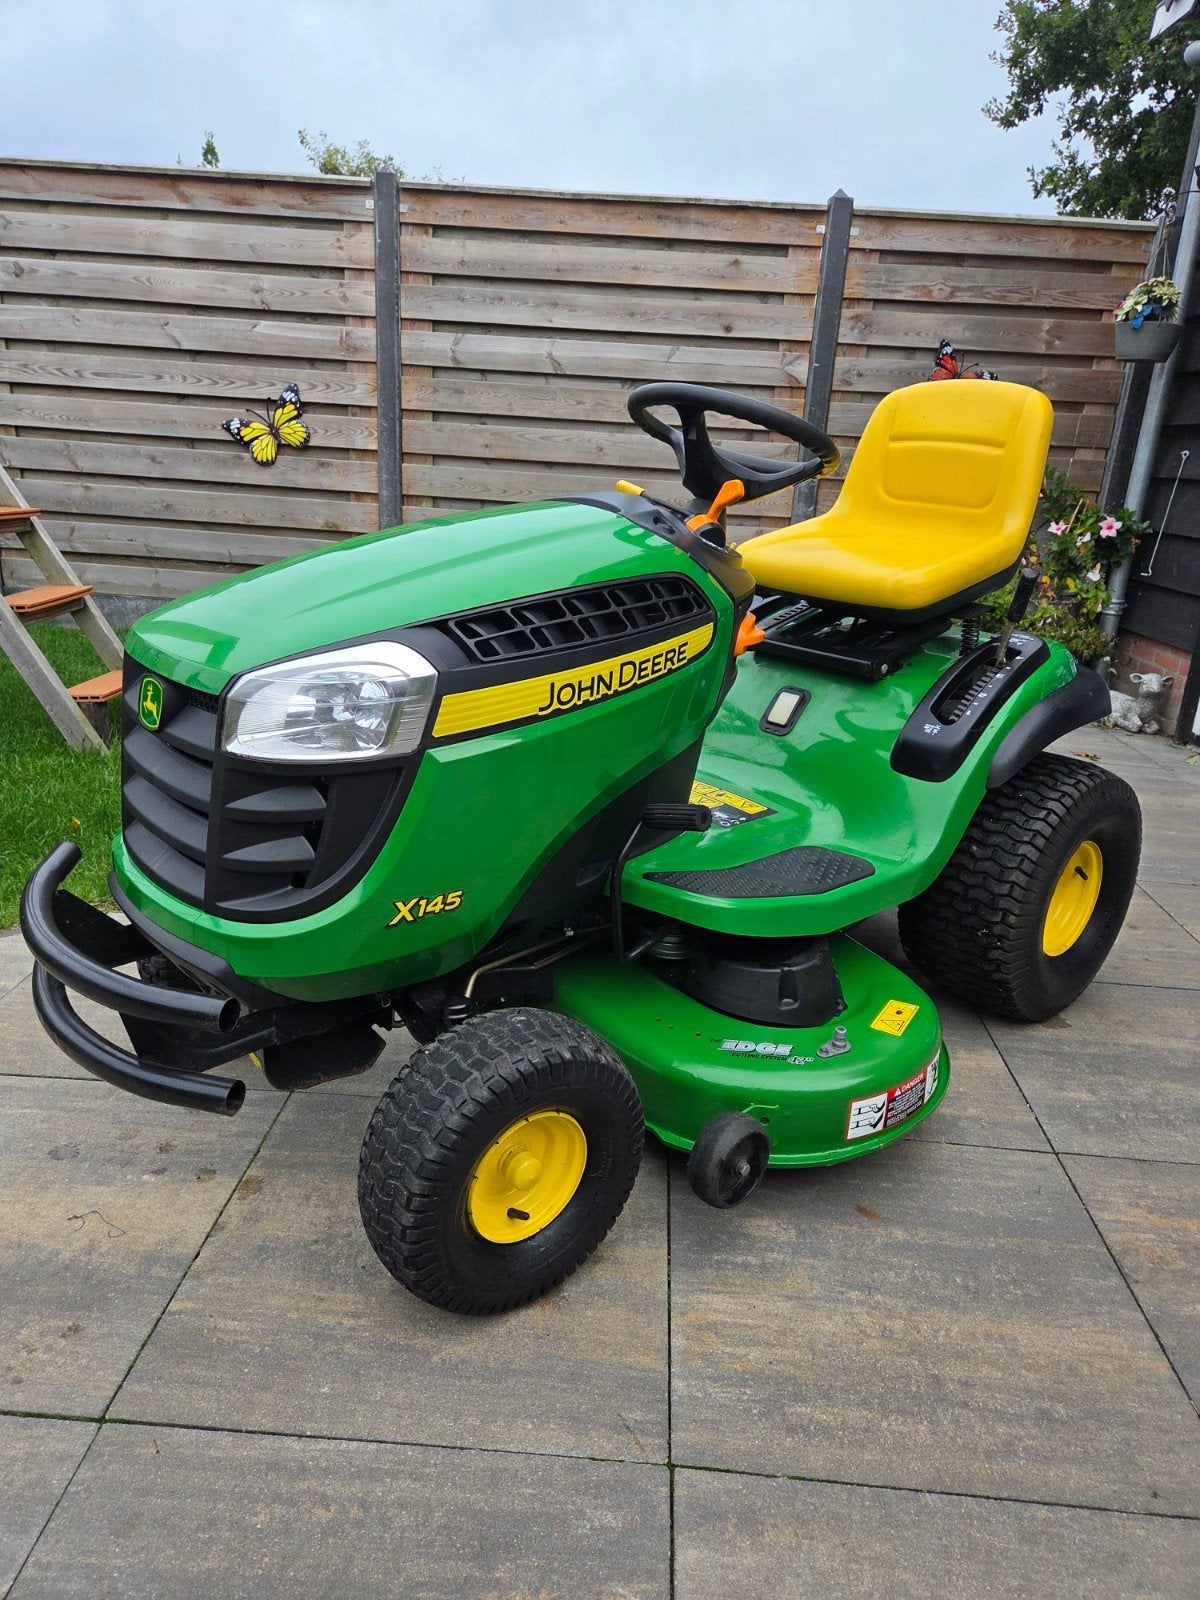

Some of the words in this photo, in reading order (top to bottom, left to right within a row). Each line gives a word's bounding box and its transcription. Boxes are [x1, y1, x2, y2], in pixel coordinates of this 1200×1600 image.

[538, 671, 612, 711] JOHN
[618, 642, 689, 688] DEERE
[386, 890, 464, 926] X145
[718, 1038, 793, 1056] EDGE
[901, 1073, 924, 1093] DANGER
